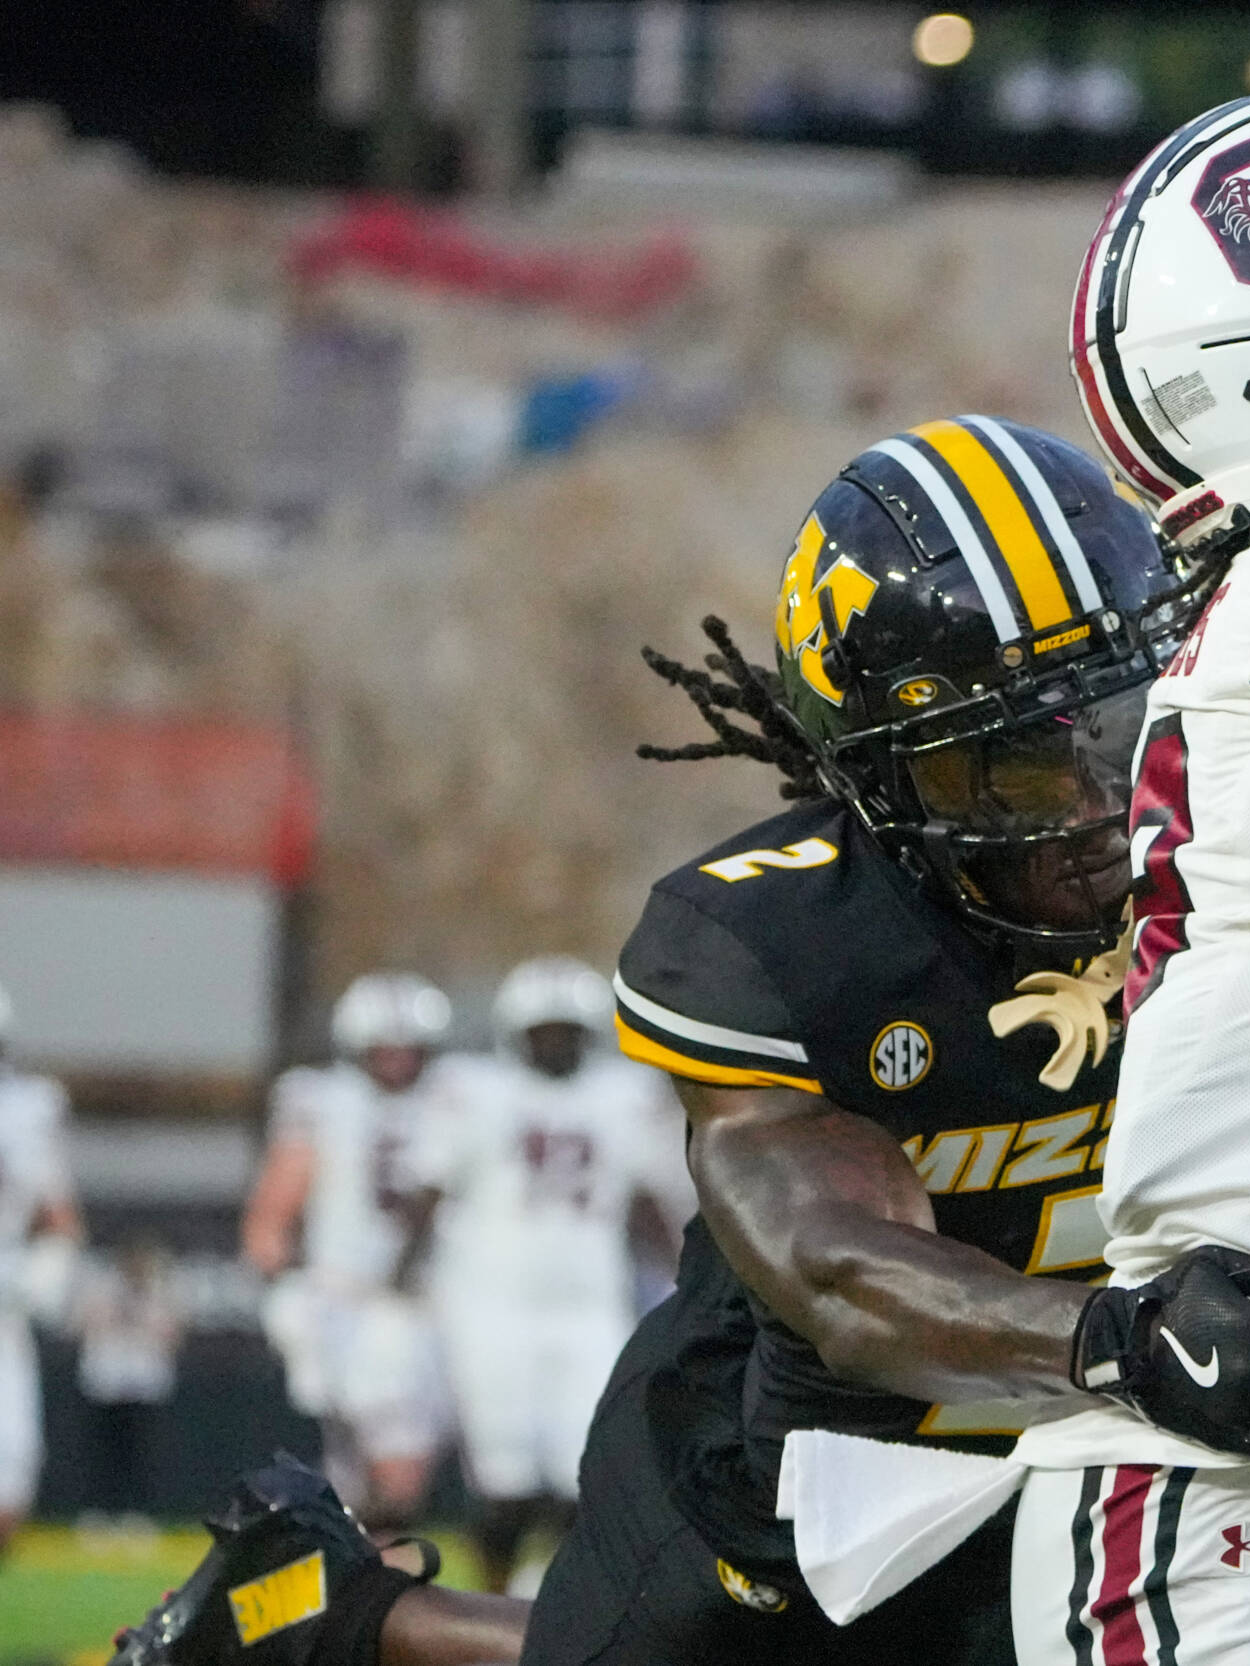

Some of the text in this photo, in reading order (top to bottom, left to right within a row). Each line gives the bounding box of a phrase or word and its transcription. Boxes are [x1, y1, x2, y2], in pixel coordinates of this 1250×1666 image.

[1033, 624, 1091, 655] MIZZOU
[699, 837, 839, 883] 2
[874, 1021, 931, 1089] SEC
[901, 1100, 1117, 1195] MIZ
